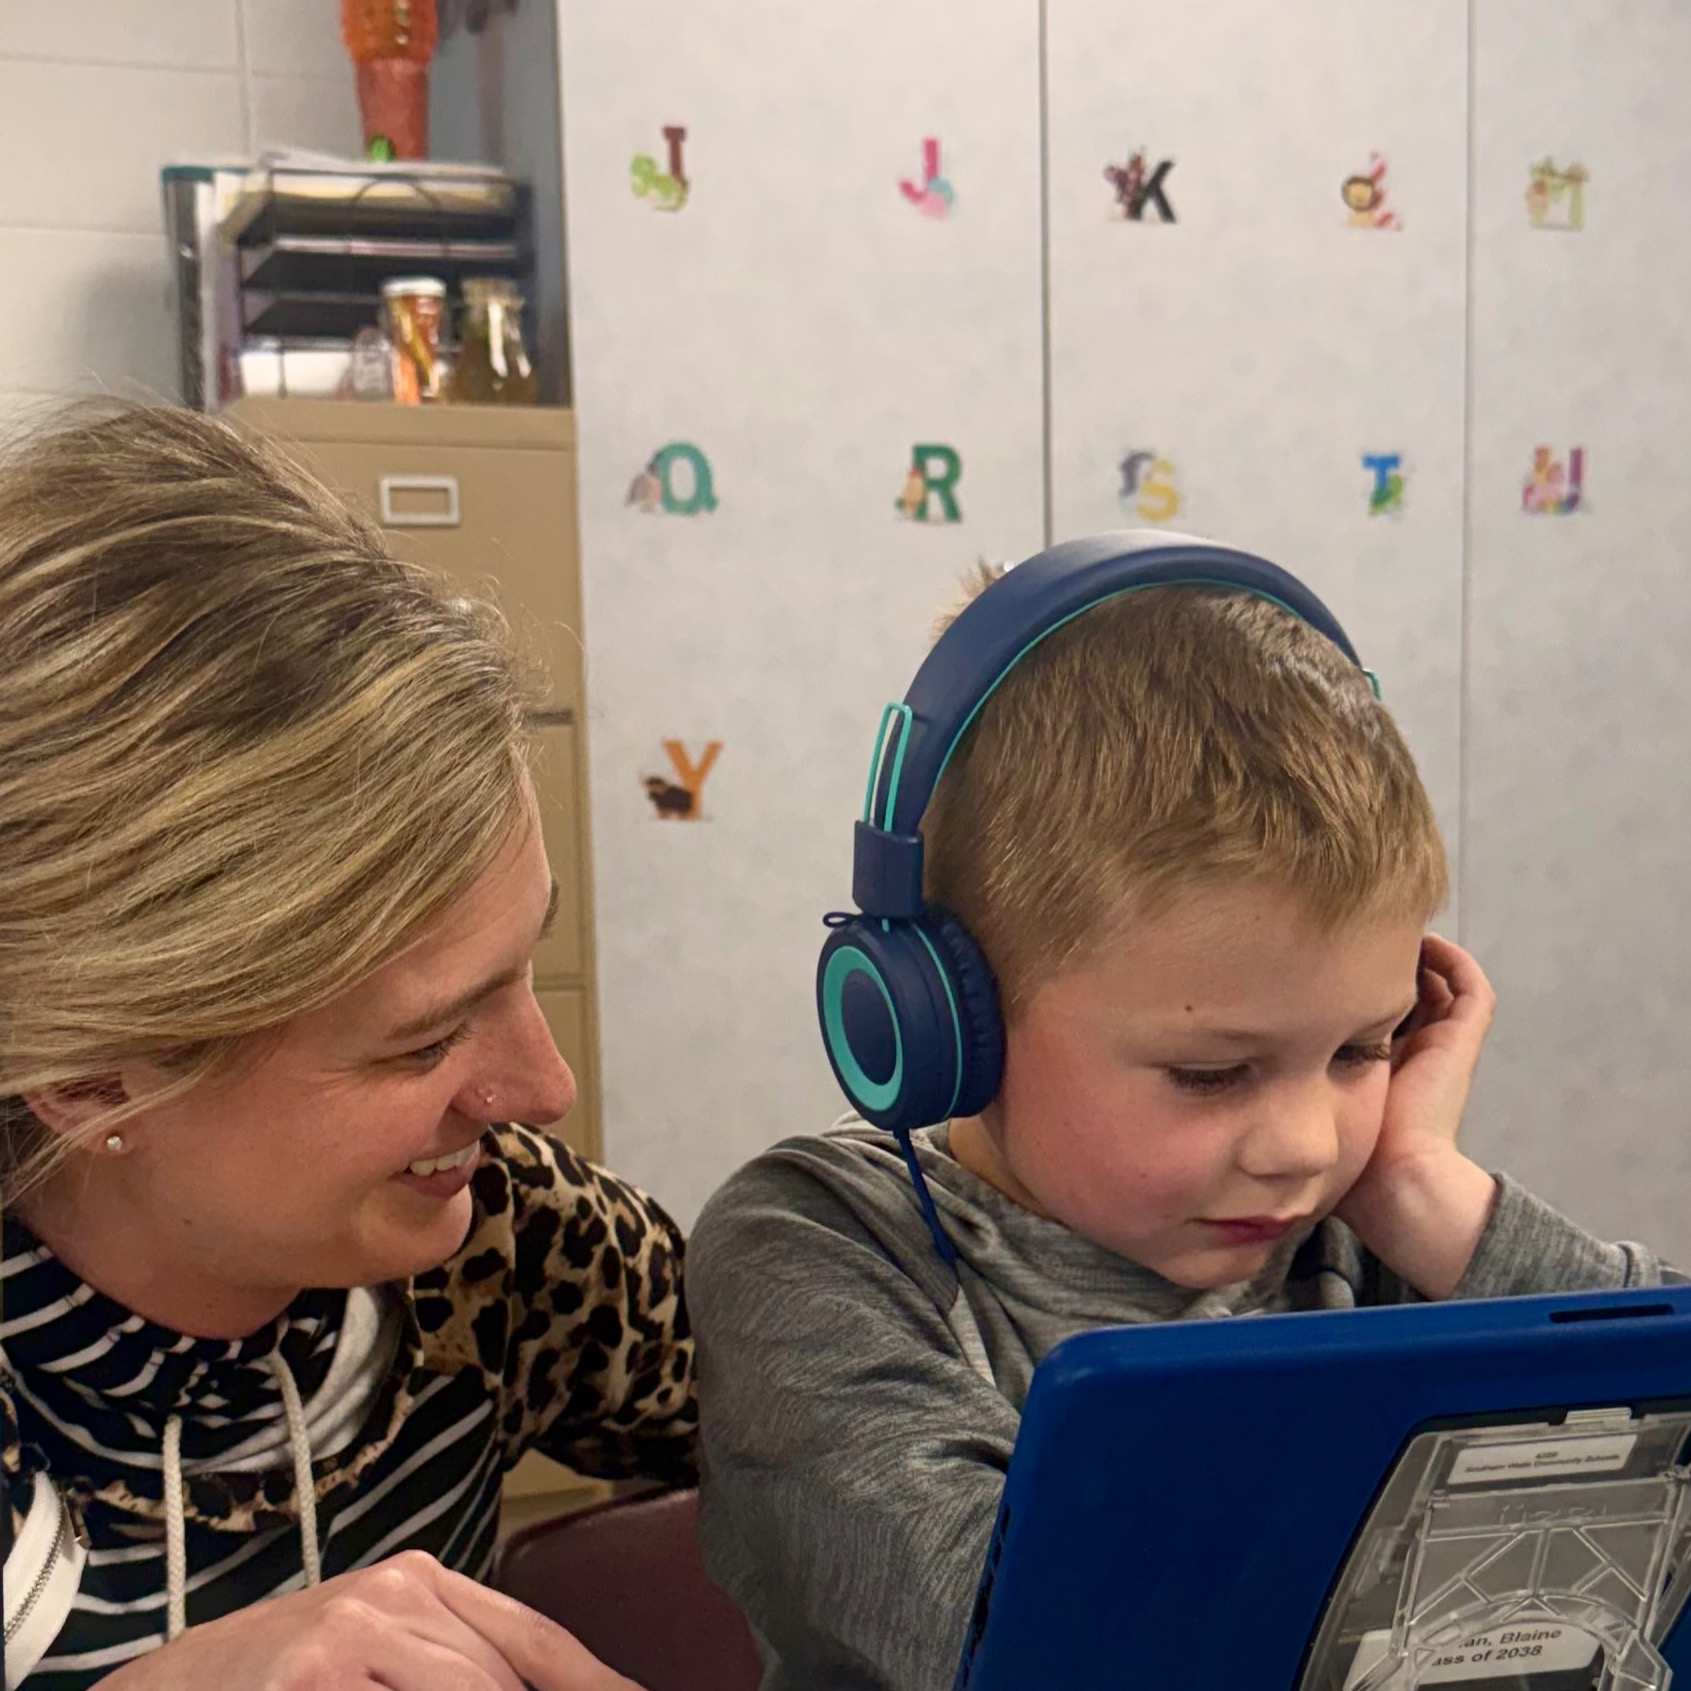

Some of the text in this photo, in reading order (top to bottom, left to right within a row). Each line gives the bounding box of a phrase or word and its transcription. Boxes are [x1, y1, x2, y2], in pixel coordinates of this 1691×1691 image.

[1124, 159, 1179, 225] K
[909, 443, 963, 523] R
[1361, 453, 1402, 517] T
[662, 739, 725, 824] Y
[1431, 1644, 1543, 1667] ass of 2038
[1458, 1629, 1562, 1649] an, Blaine
